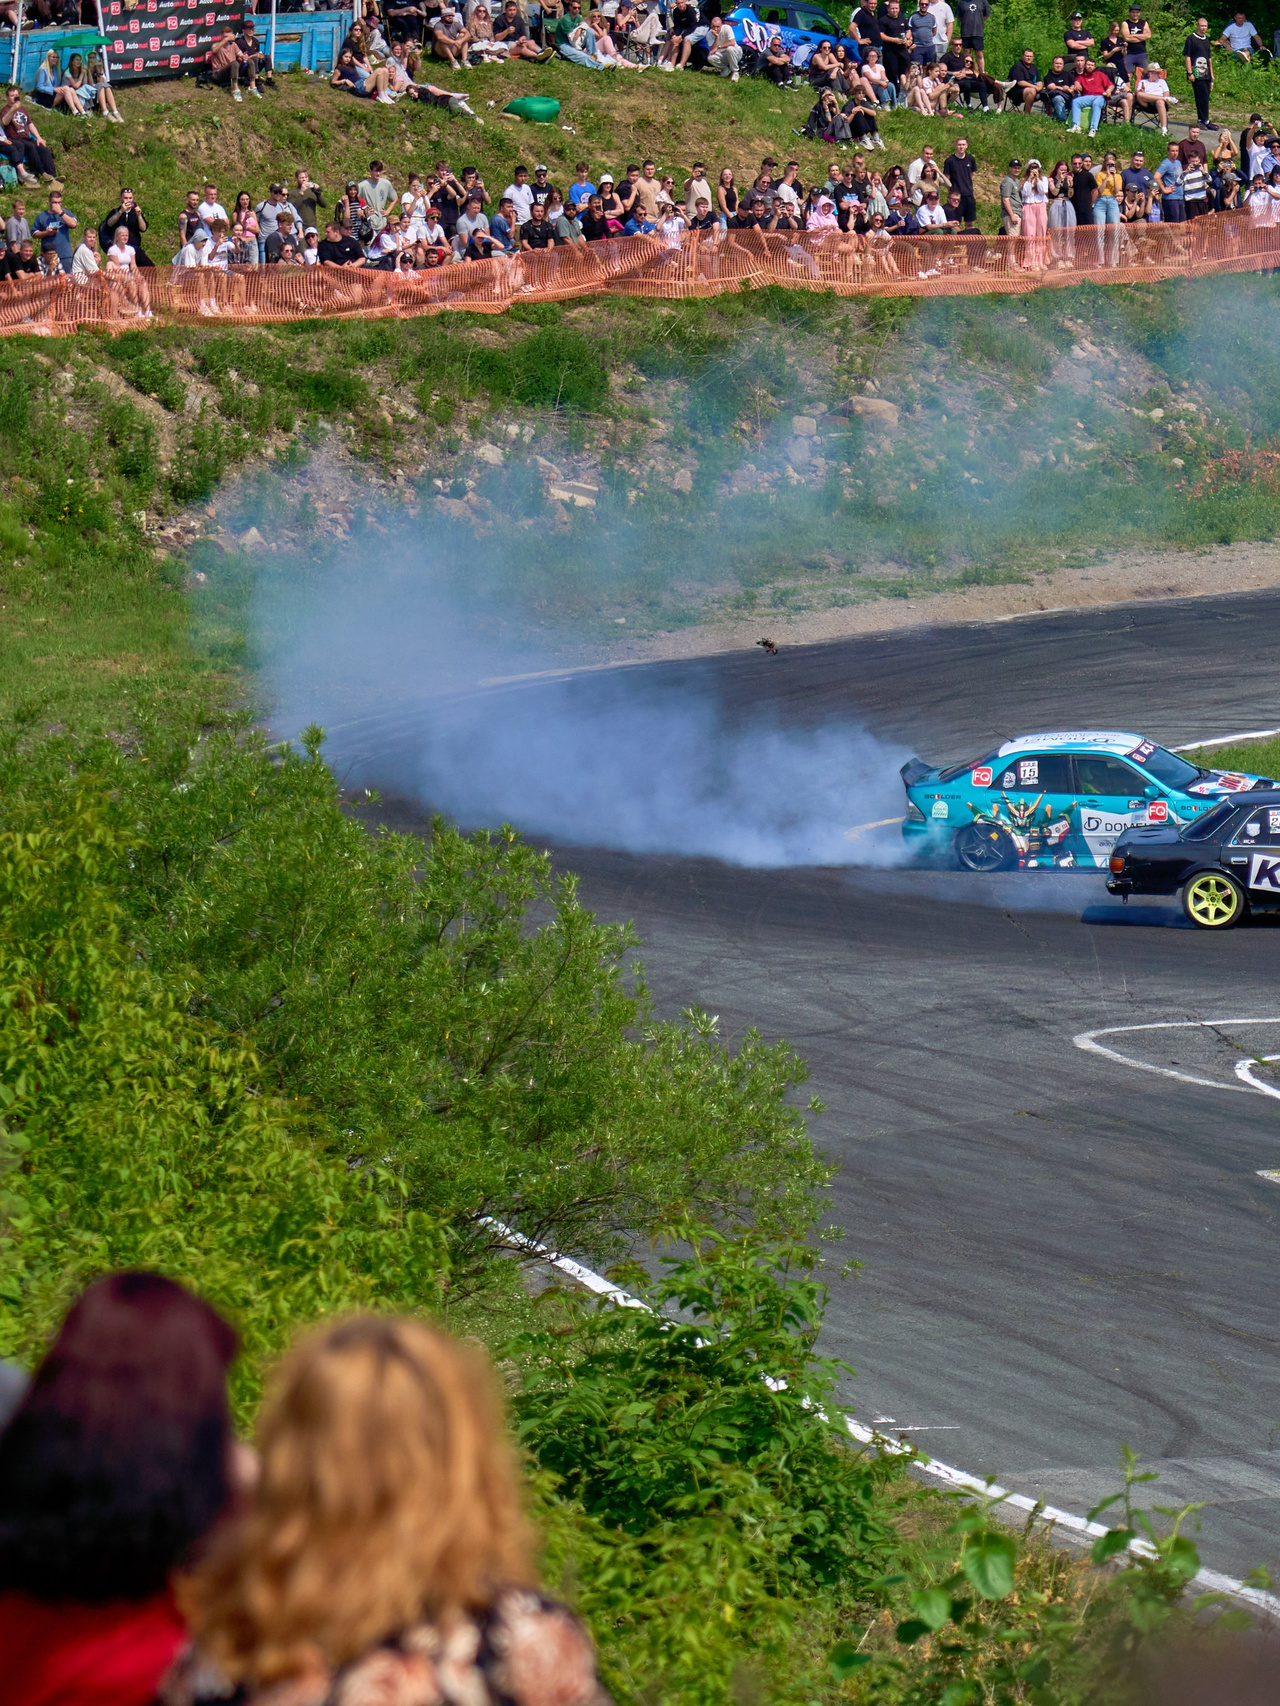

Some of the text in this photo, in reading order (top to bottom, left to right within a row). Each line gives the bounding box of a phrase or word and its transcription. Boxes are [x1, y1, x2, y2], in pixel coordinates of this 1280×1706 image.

[973, 771, 991, 782] FQ
[1021, 768, 1036, 778] 15
[1148, 805, 1166, 817] FQ
